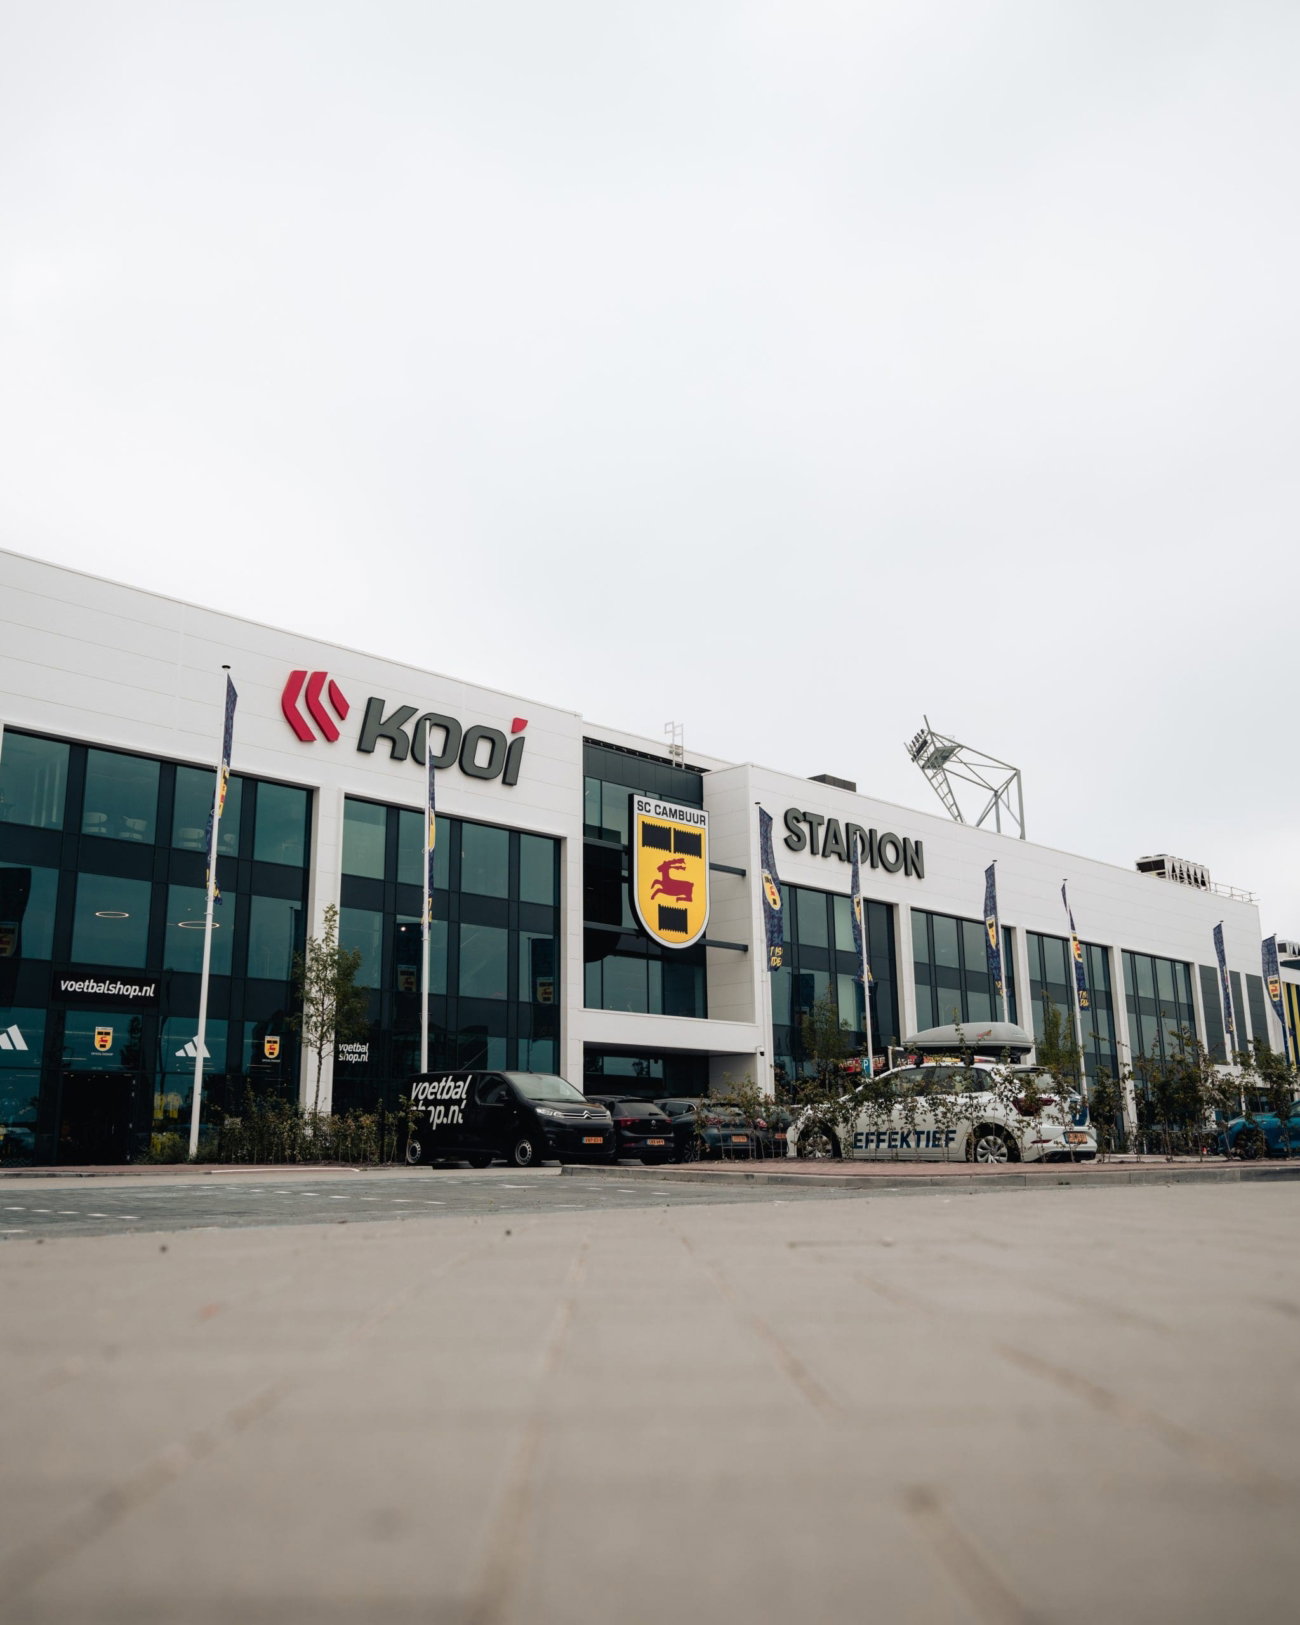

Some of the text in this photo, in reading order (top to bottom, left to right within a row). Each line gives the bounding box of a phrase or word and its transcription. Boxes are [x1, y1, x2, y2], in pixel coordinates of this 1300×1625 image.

[637, 800, 706, 826] SC CAMBUUR
[783, 807, 925, 879] STADION
[60, 979, 155, 999] voetbalshop.nl
[338, 1042, 369, 1053] voetbal
[411, 1074, 473, 1100] voetbal
[853, 1129, 957, 1149] EFFEKTIEF
